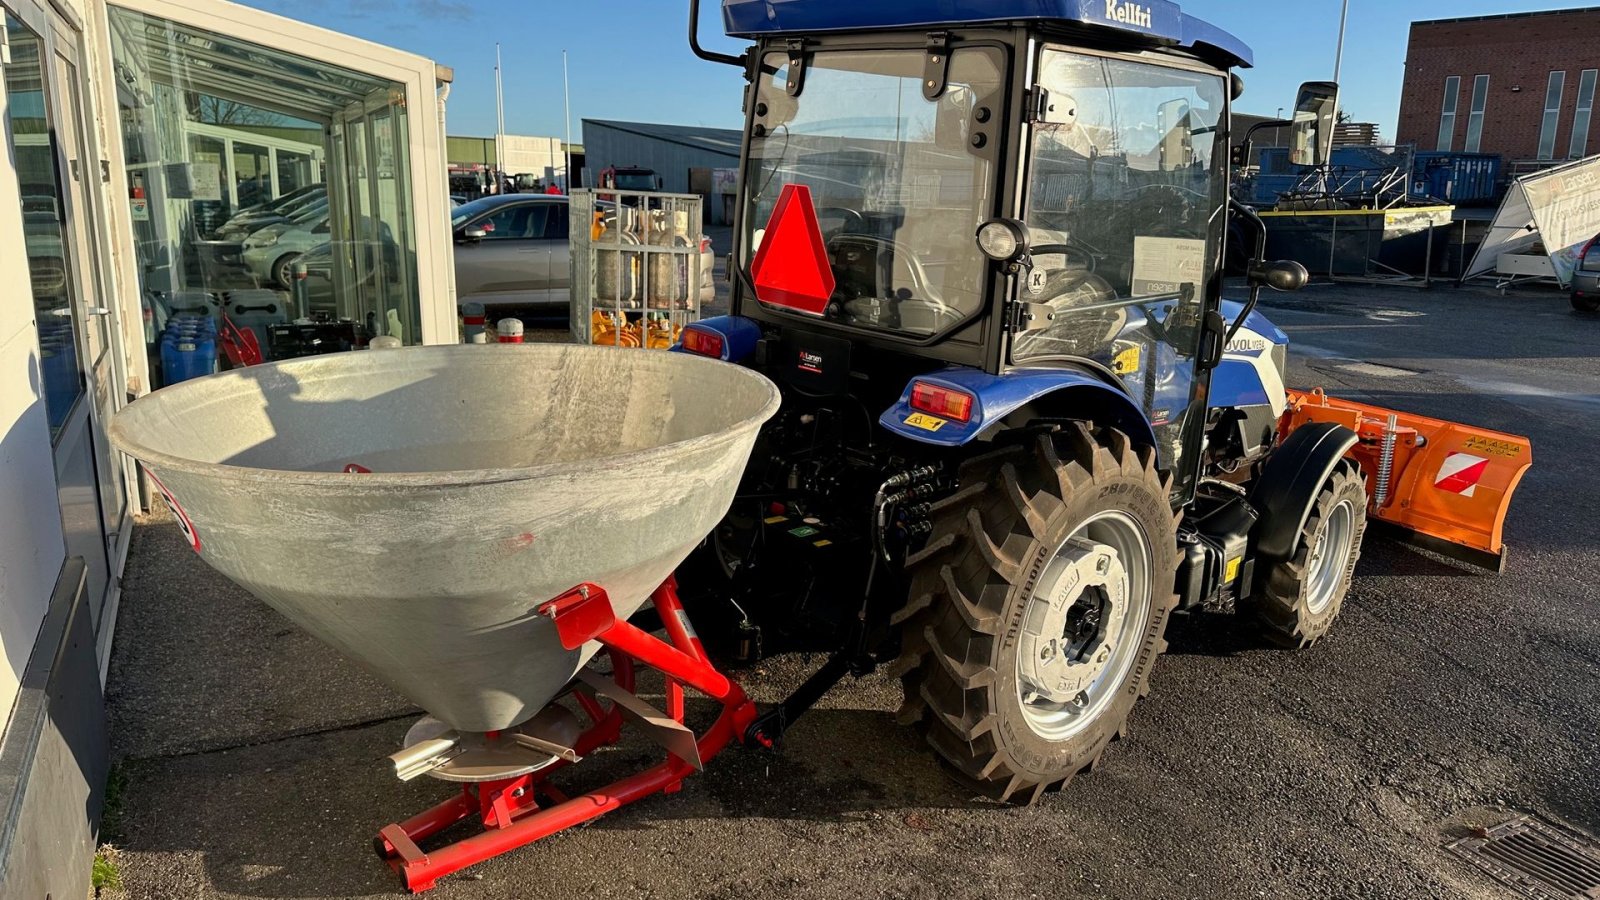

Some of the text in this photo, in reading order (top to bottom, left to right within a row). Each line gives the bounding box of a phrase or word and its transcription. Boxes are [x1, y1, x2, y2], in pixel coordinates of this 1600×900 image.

[1105, 0, 1151, 29] Kellfri
[1033, 273, 1042, 286] K
[1224, 339, 1252, 351] OVOL
[805, 352, 822, 363] Larsen
[1003, 546, 1048, 650] TRELLEBORG
[1128, 606, 1166, 695] TRELLEBORG
